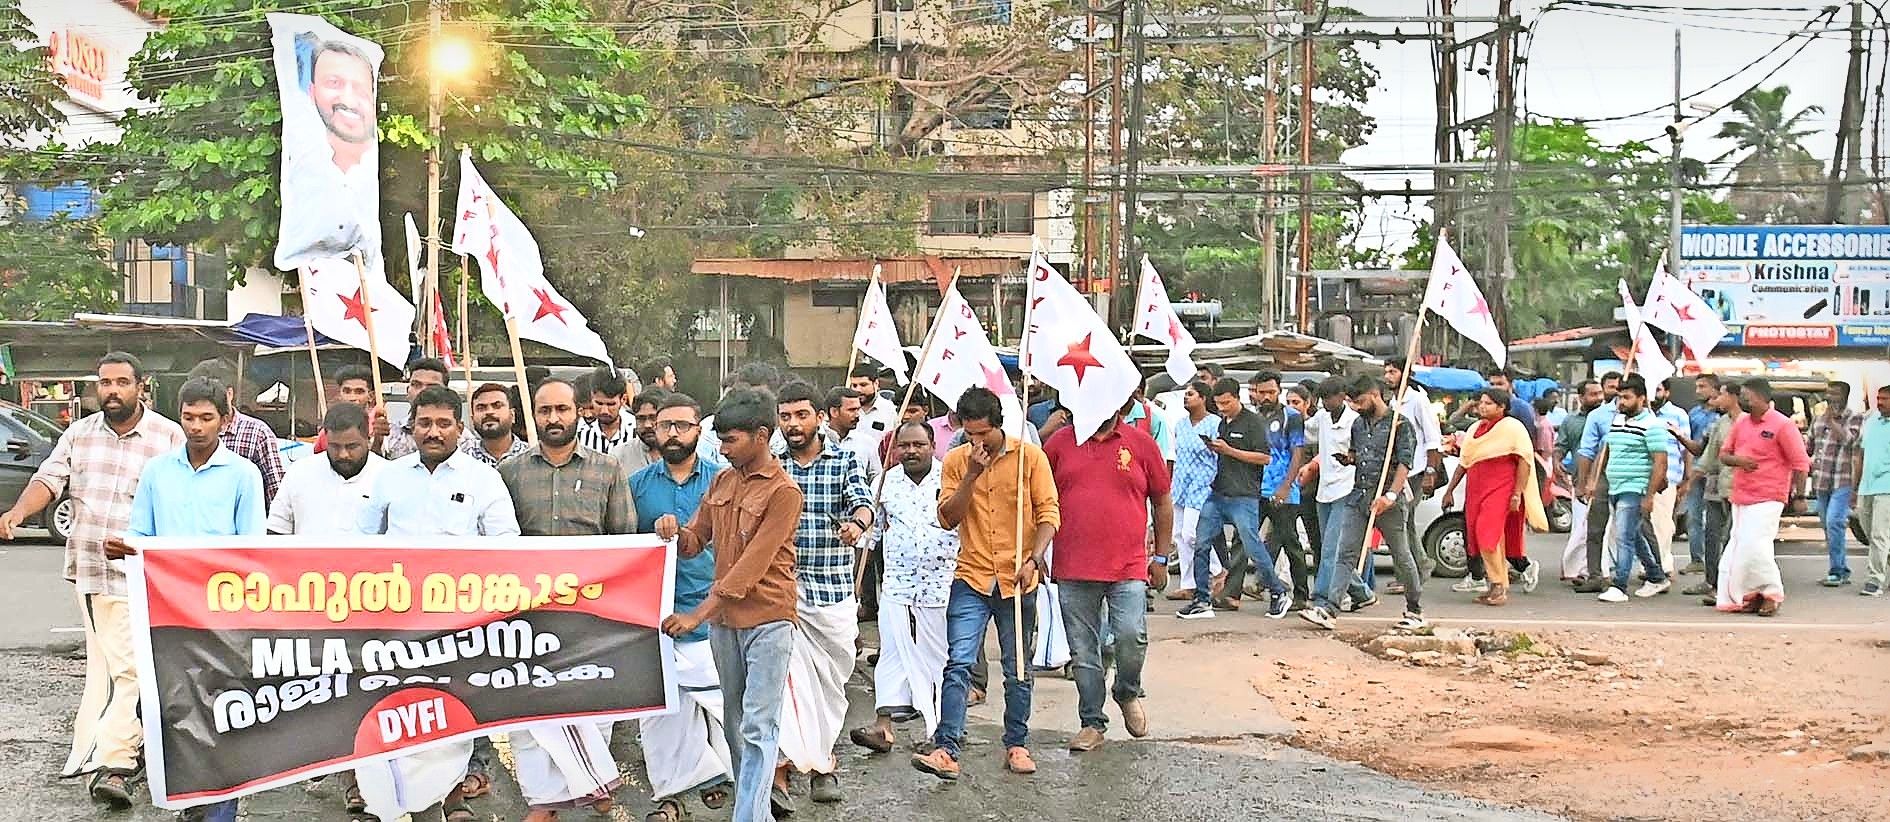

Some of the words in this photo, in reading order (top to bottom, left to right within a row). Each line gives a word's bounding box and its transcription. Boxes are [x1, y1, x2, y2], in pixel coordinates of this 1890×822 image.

[1681, 233, 1759, 257] MOBILE
[1763, 233, 1890, 257] ACCESSORIE
[1754, 263, 1829, 281] Krishna
[1751, 284, 1829, 294] Communication
[1750, 326, 1831, 339] PHOTOSTAT
[206, 561, 413, 623] രാഹുൽ
[251, 637, 353, 679] MLA
[361, 618, 561, 673] സ്ഥാനം
[377, 696, 448, 745] DYFI
